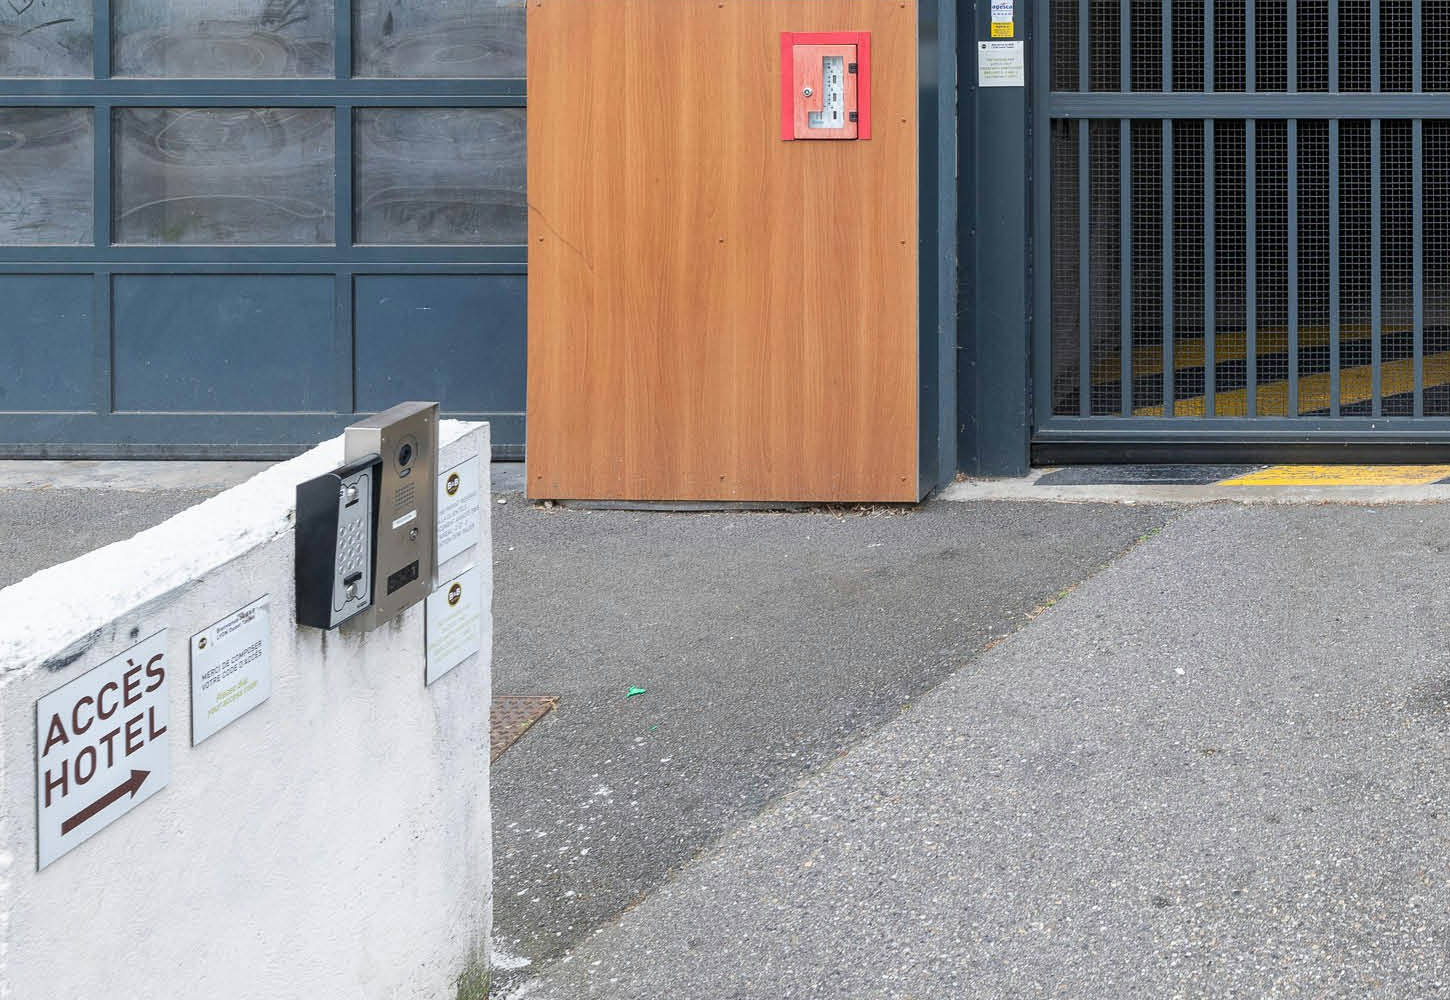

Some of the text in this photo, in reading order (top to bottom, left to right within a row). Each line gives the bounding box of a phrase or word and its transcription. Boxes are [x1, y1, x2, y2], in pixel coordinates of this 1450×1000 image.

[201, 640, 262, 681] MERCI DE COMPOSER
[201, 674, 221, 691] VOTRE
[222, 664, 238, 679] CODE
[42, 653, 165, 758] ACCÈS
[45, 705, 167, 808] HOTEL
